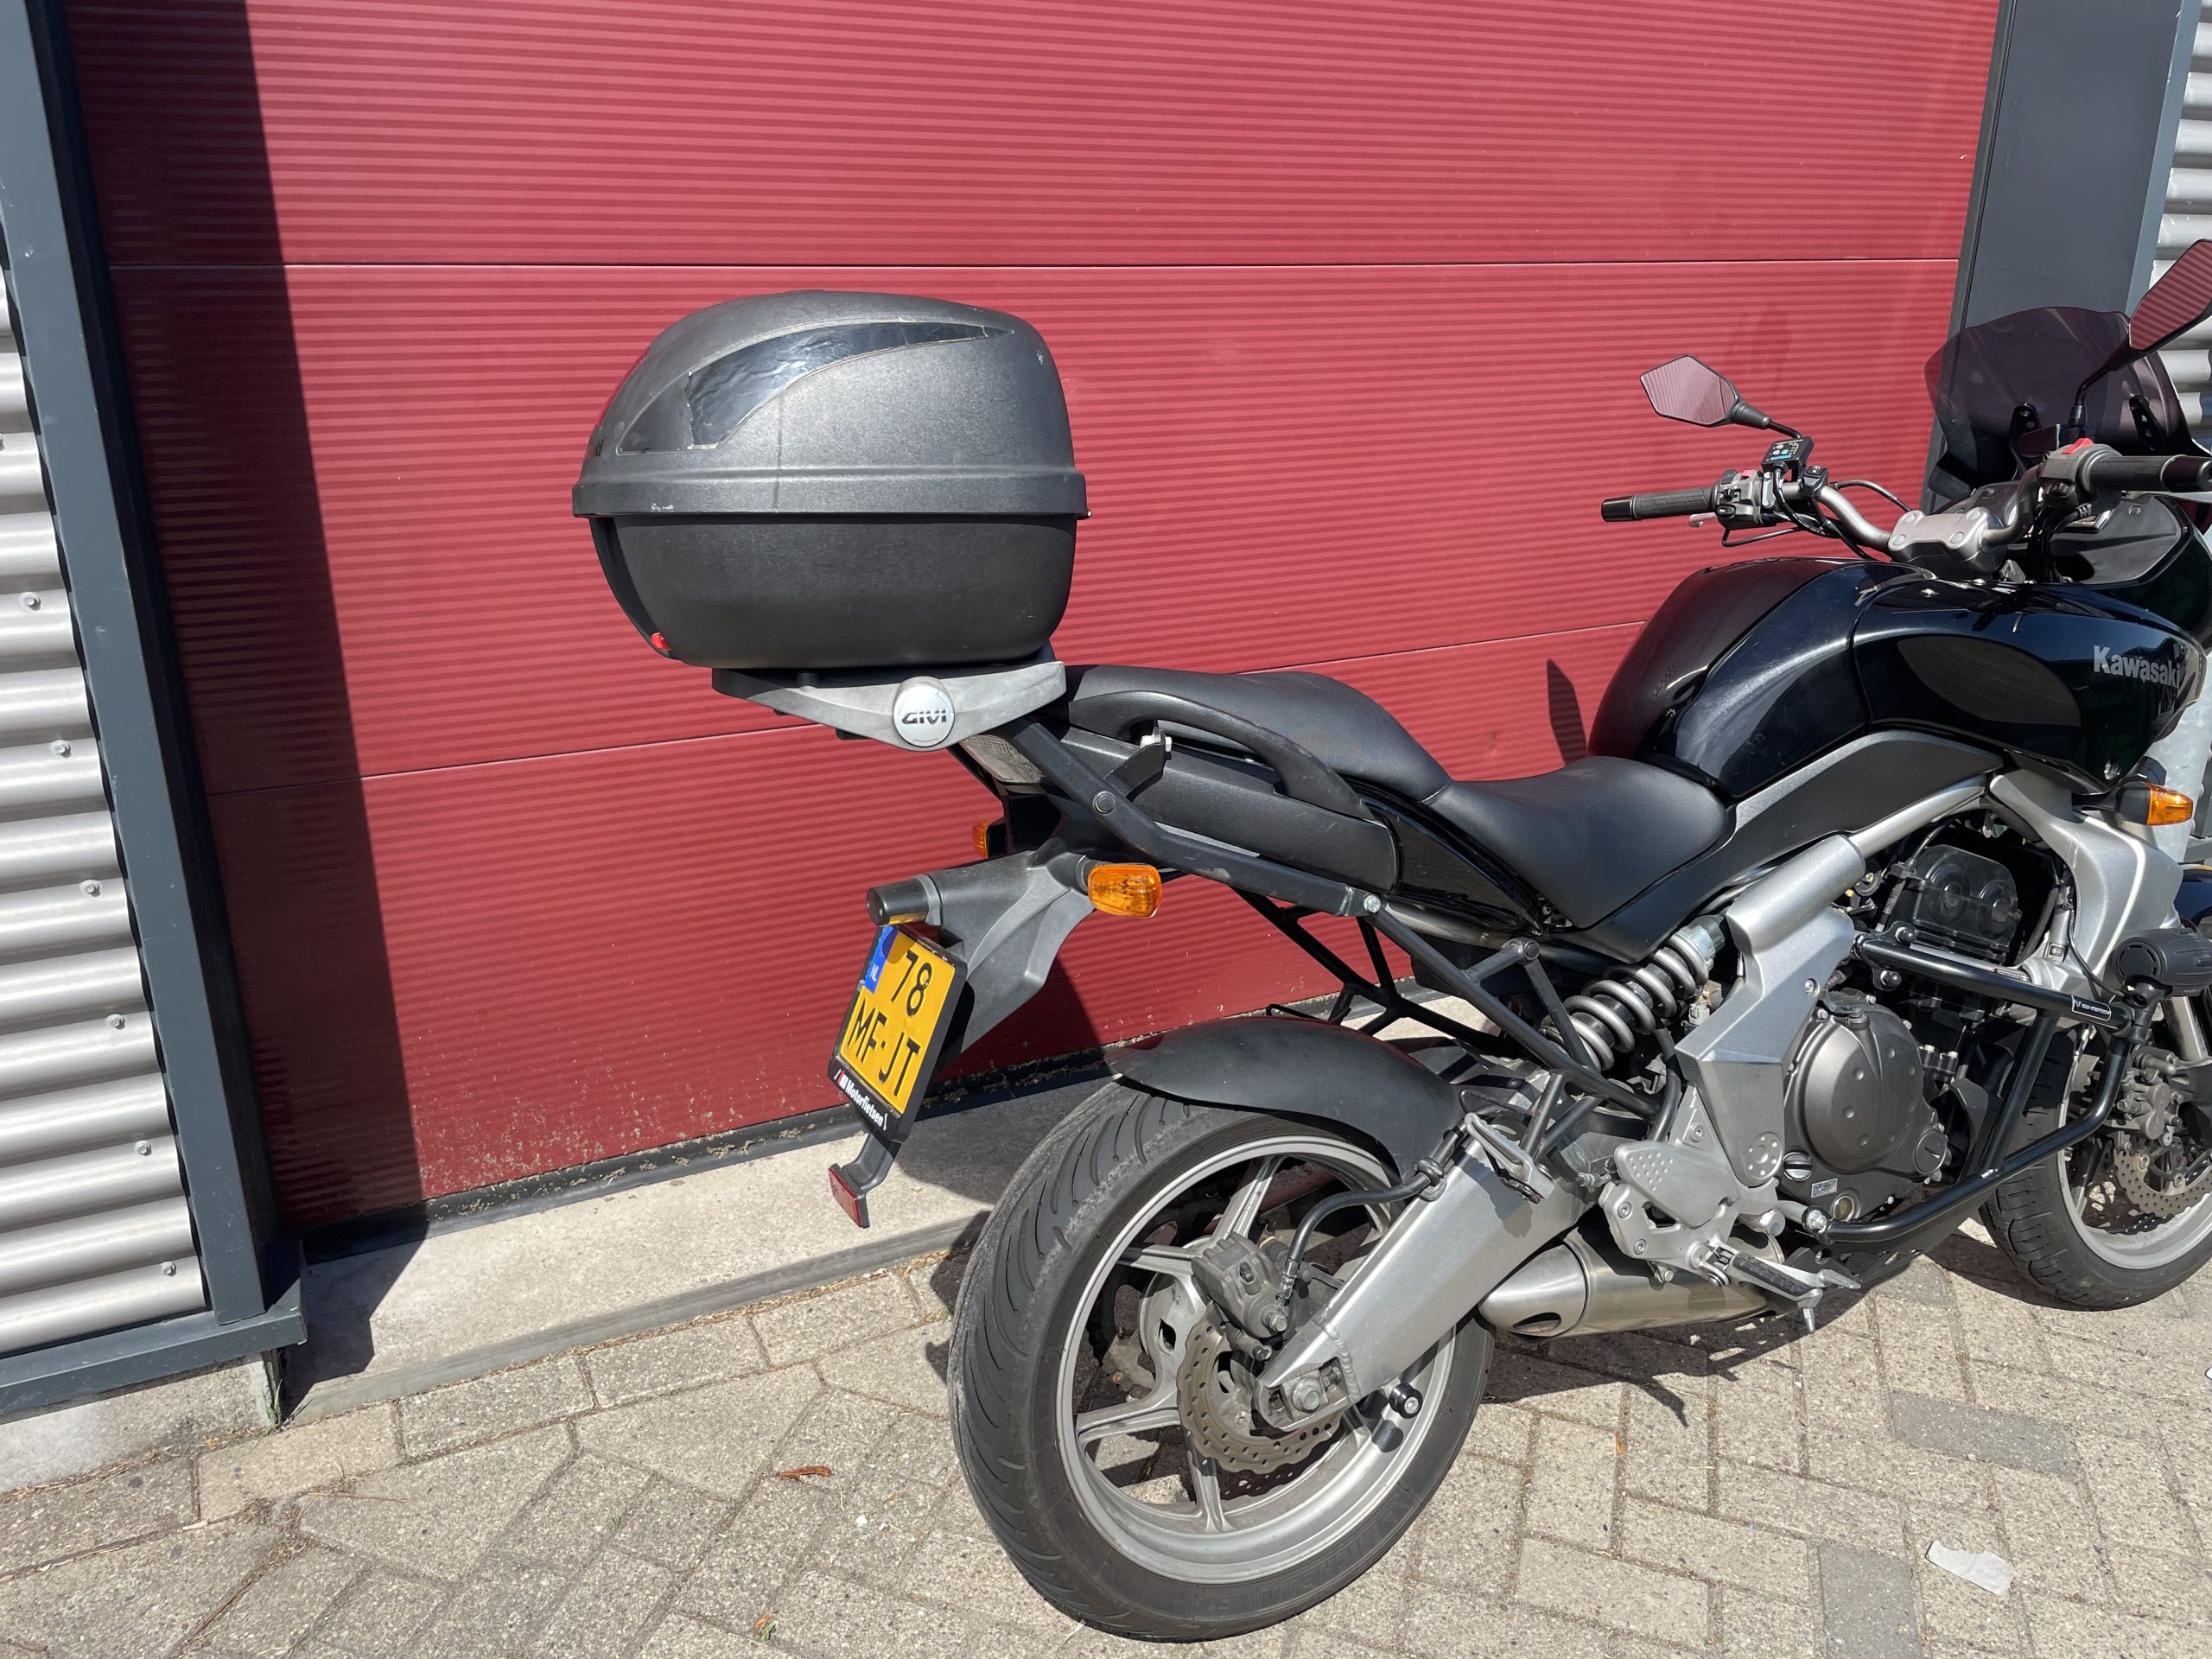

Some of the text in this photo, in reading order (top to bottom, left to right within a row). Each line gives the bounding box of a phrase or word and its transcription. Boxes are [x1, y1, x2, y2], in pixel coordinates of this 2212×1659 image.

[2094, 645, 2180, 689] Kawasaki
[901, 709, 947, 725] GIVI
[869, 963, 878, 982] NL
[891, 949, 932, 1017] 78
[845, 1079, 884, 1128] Motorfietsen
